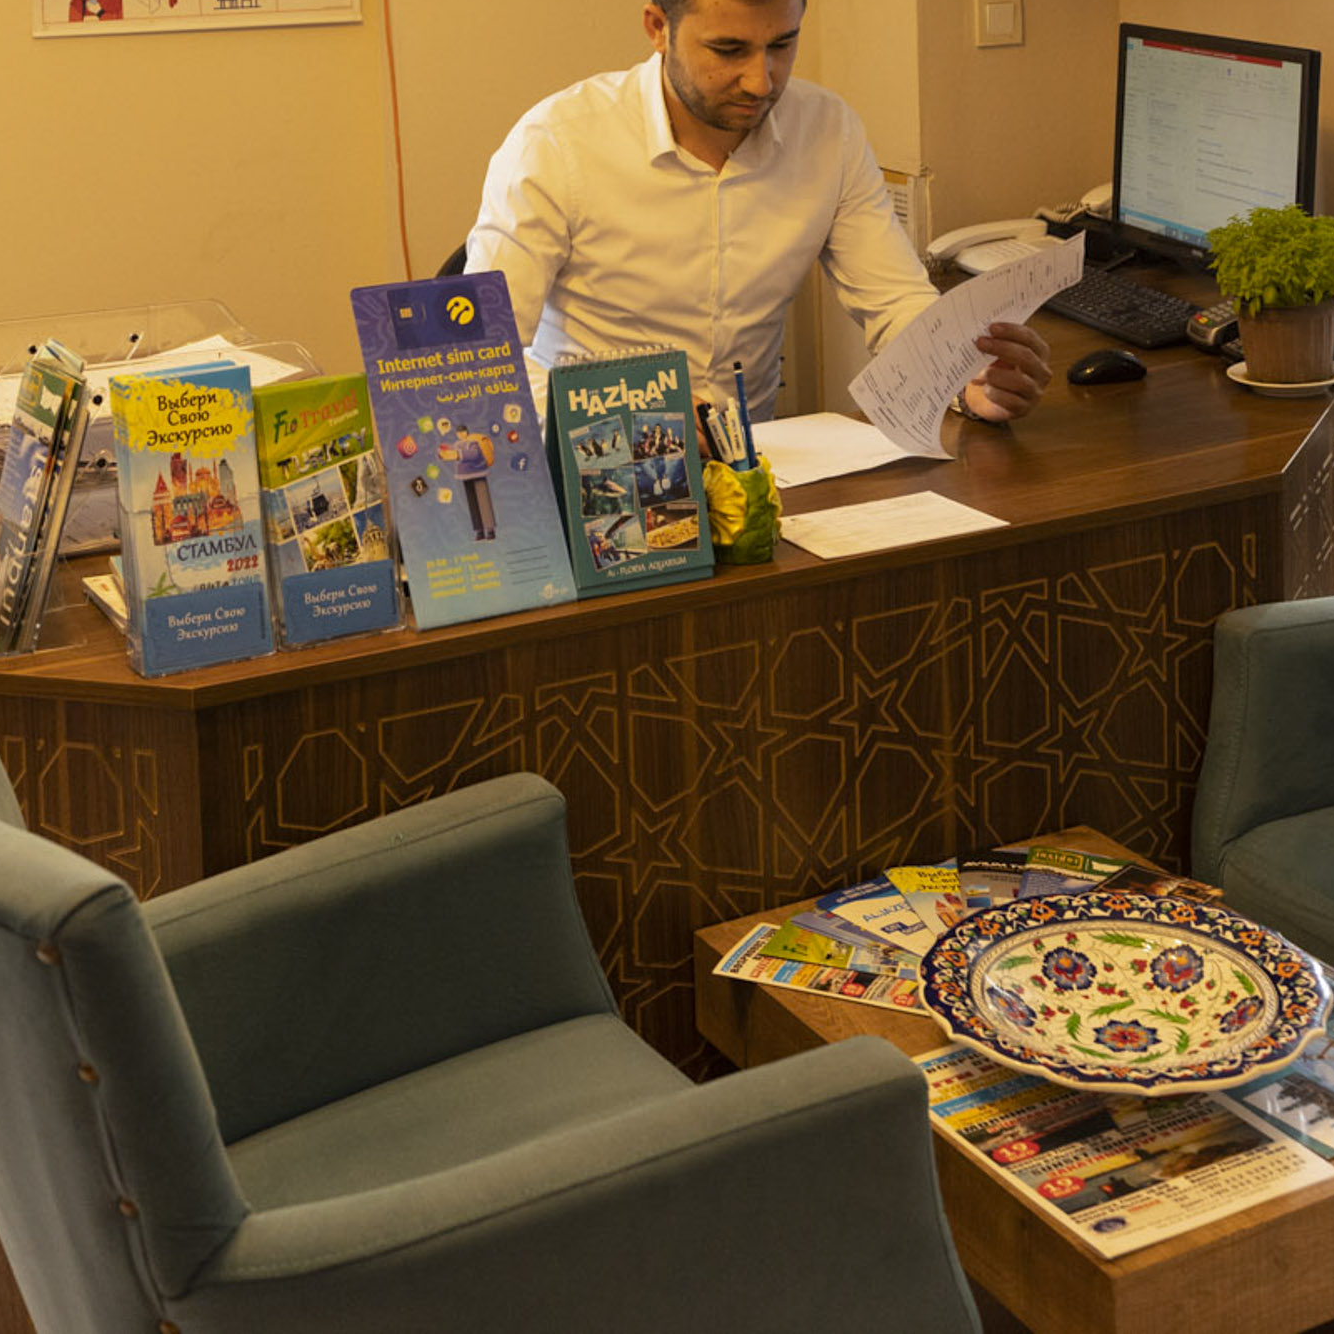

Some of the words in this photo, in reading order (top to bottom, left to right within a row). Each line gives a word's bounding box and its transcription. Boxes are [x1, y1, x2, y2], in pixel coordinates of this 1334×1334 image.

[377, 352, 444, 374] Internet
[446, 348, 475, 364] sim
[478, 341, 512, 360] card
[380, 364, 516, 394] Интернет-сим-карта
[157, 391, 217, 412] Выбери
[568, 369, 678, 417] HAZİRAN
[167, 410, 210, 427] Свою
[146, 423, 233, 446] Экскурсию
[276, 427, 367, 480] TURKEY
[177, 534, 257, 562] СТАМБУЛ
[227, 555, 260, 572] 2022
[304, 587, 345, 604] Выбери
[347, 583, 378, 597] Свою
[168, 611, 213, 629] Выбери
[214, 606, 247, 620] Свою
[312, 598, 371, 619] Экскурсию
[176, 622, 239, 641] Экскурсию
[999, 1141, 1028, 1158] 19
[1031, 1151, 1090, 1175] SUNSET
[1044, 1176, 1073, 1193] 19
